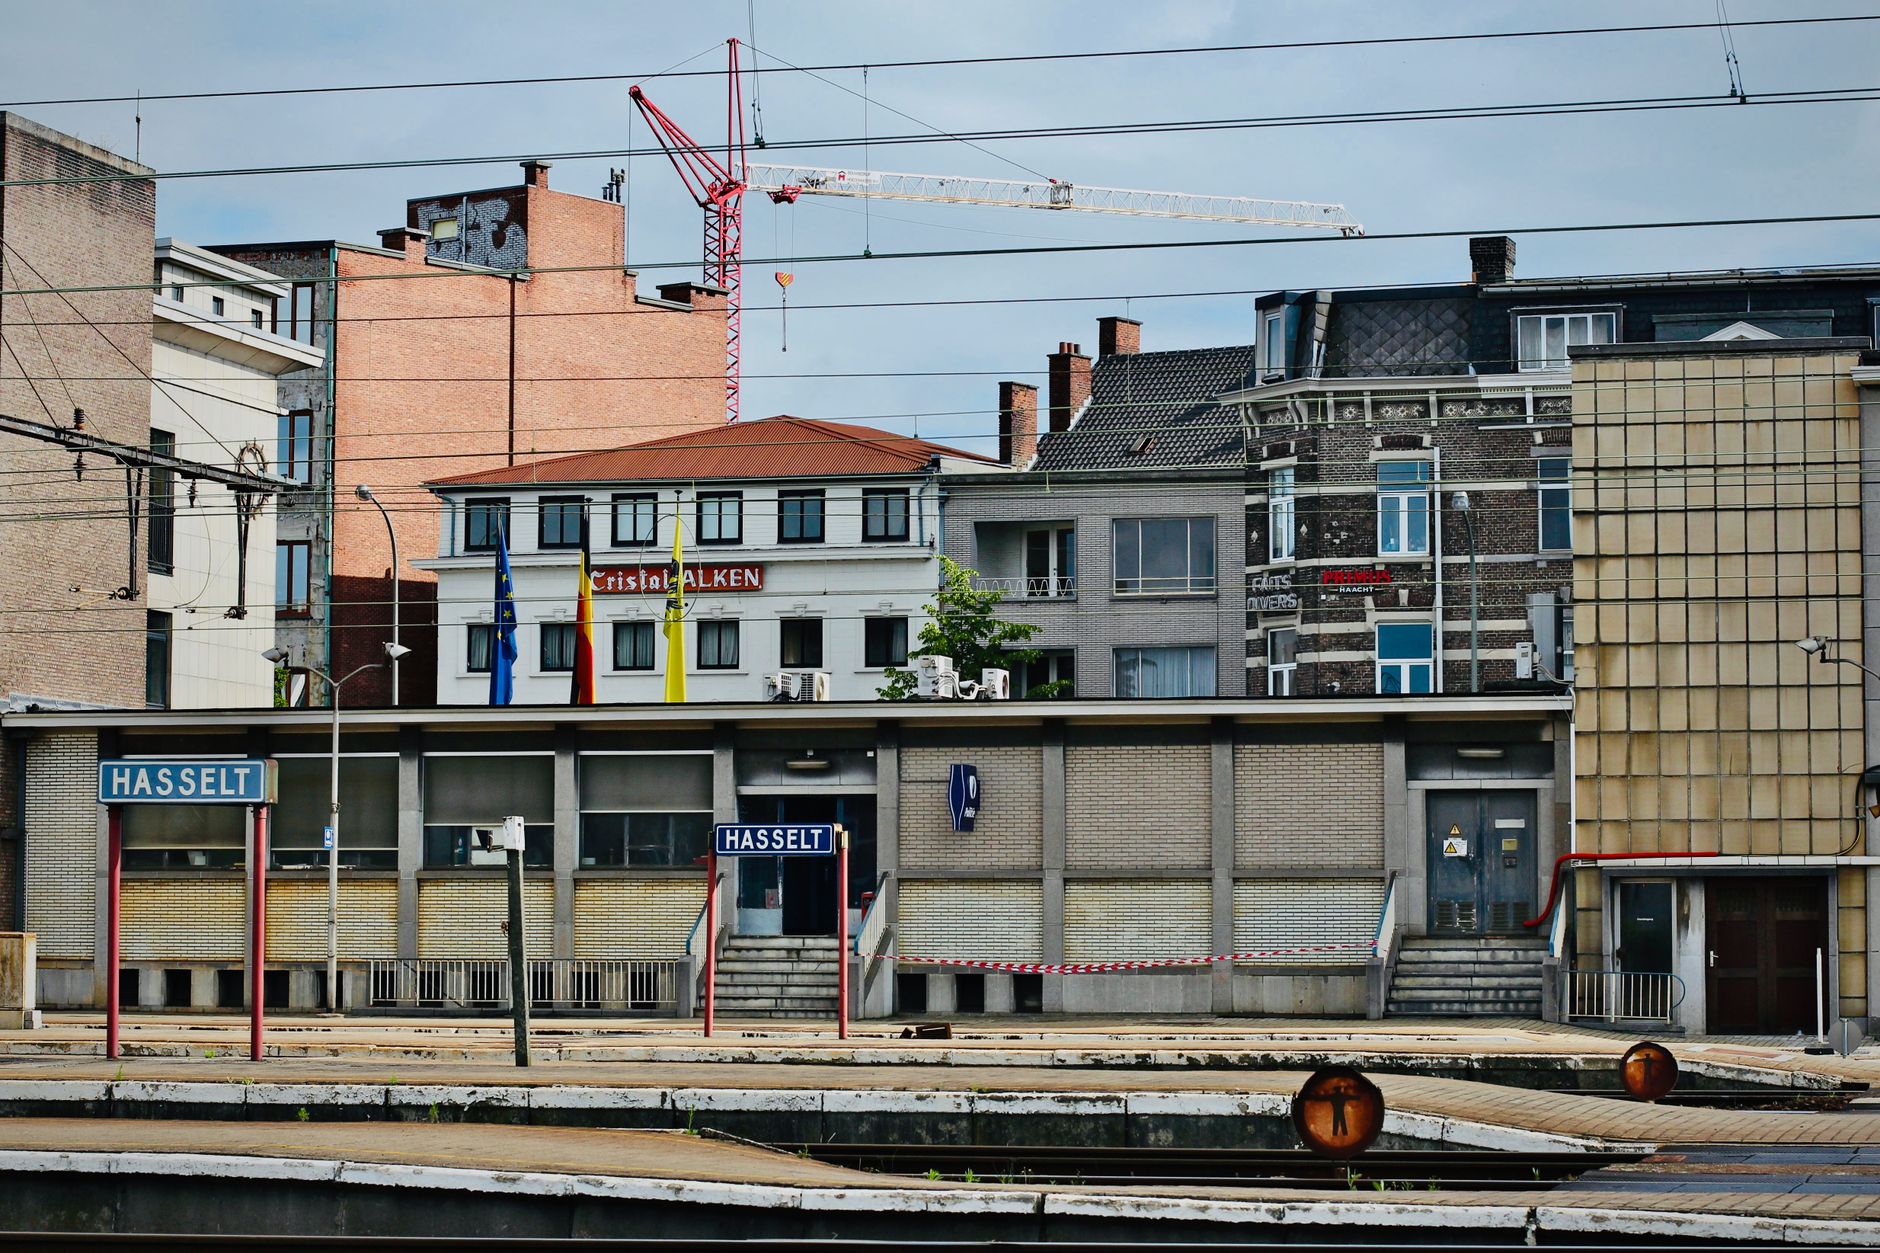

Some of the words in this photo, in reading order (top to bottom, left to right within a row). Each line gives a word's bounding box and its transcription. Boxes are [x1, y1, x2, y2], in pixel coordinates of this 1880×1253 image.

[590, 568, 669, 591] Cristal
[683, 569, 759, 588] ALKEN
[1323, 570, 1392, 585] PRIMUS
[112, 767, 251, 796] HASSELT
[725, 828, 823, 850] HASSELT
